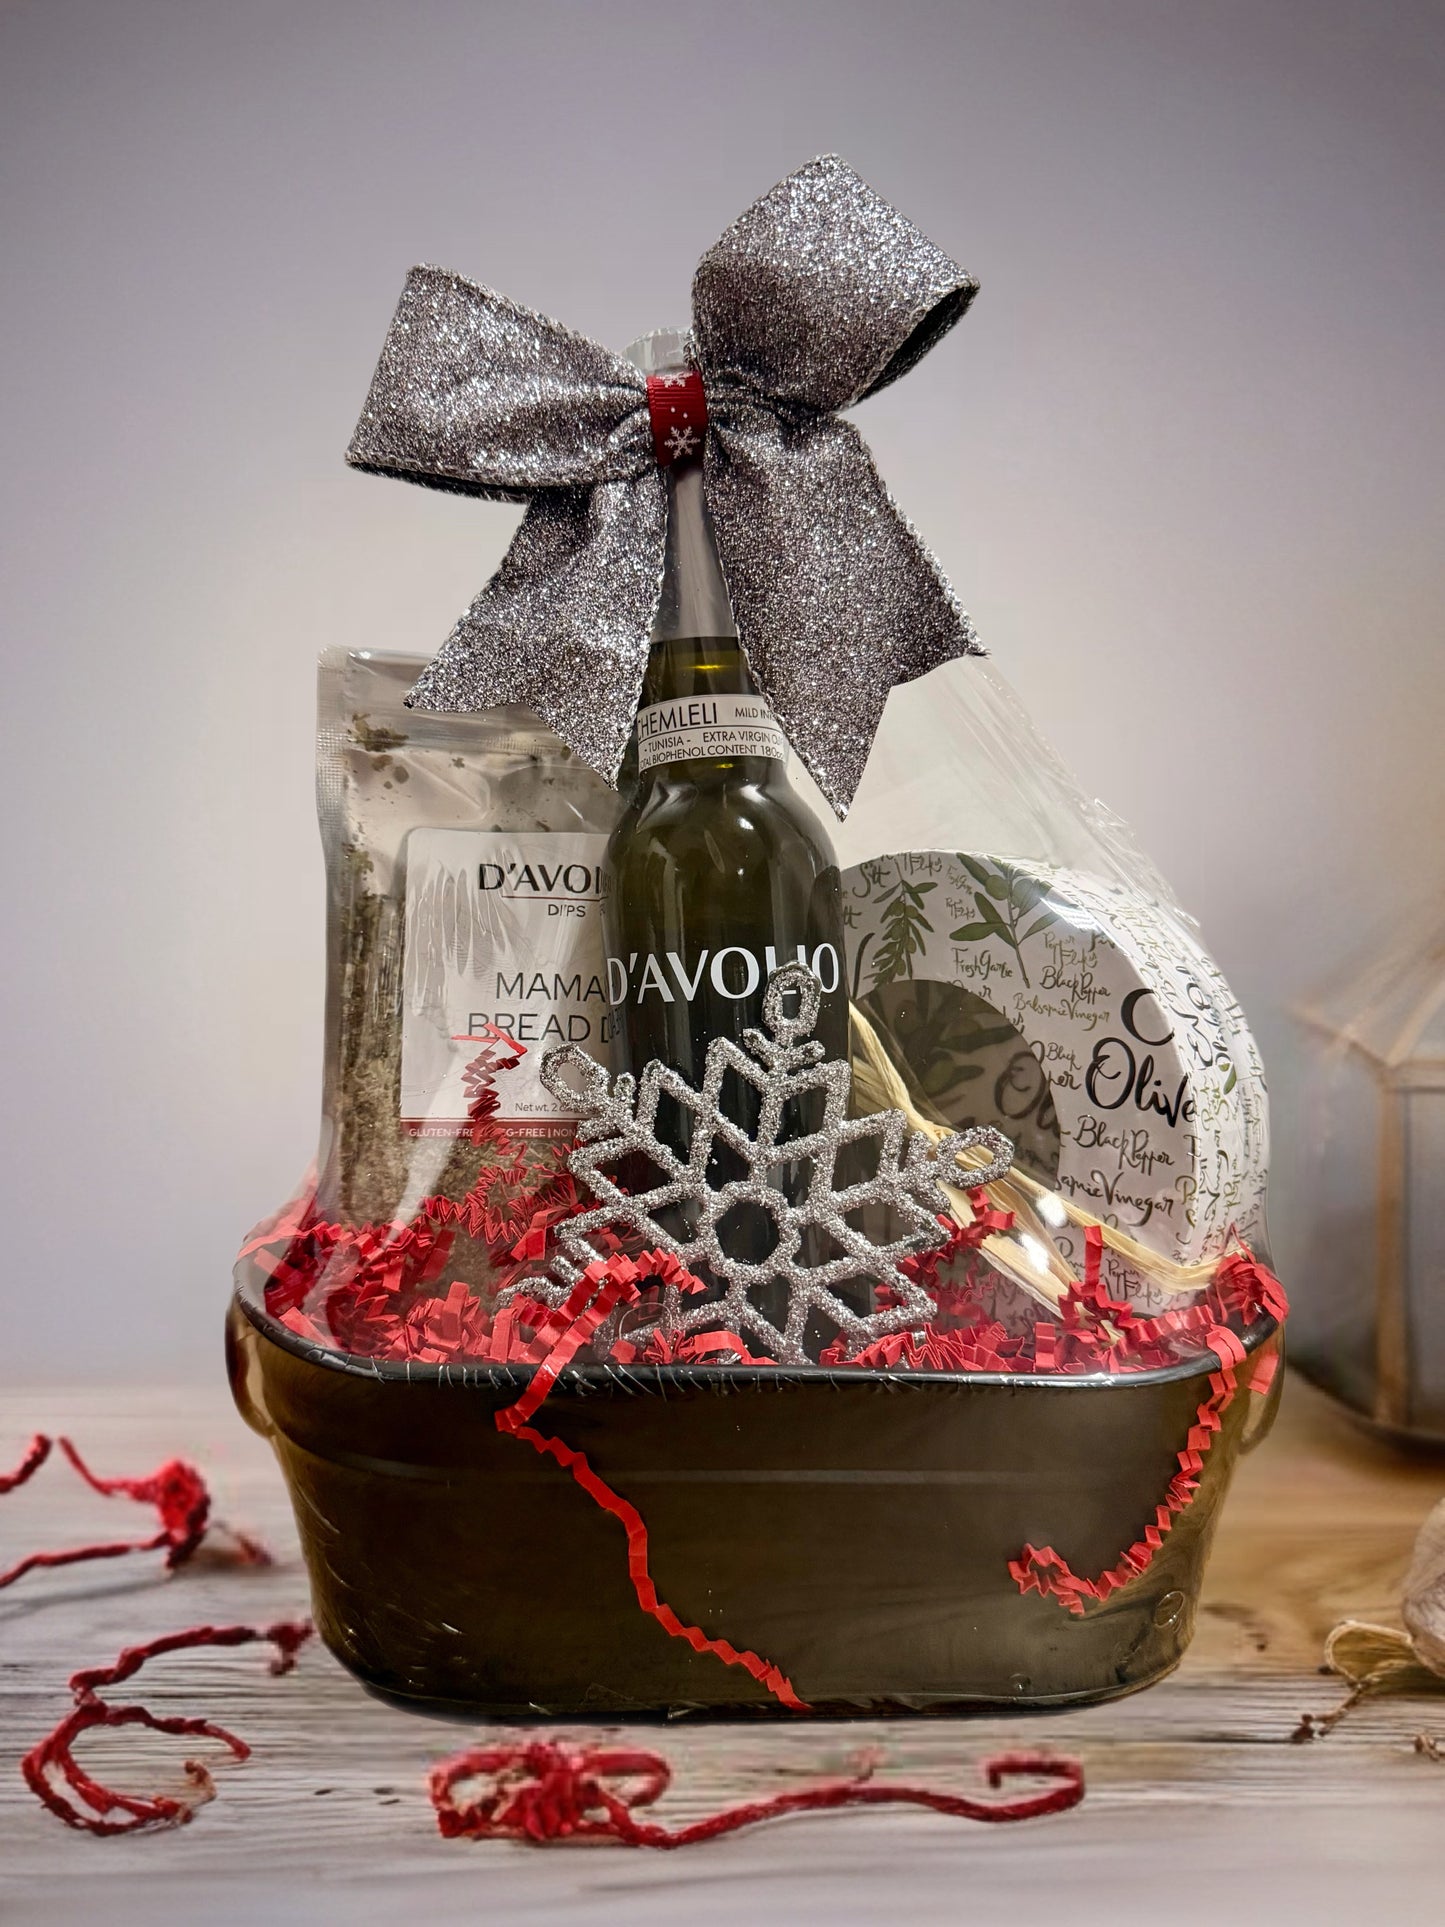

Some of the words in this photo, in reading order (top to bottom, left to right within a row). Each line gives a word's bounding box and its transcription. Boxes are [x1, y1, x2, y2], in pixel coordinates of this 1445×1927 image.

[735, 707, 758, 718] MILD
[649, 736, 684, 752] TUNISIA
[703, 731, 736, 742] EXTRA
[738, 731, 770, 743] VIRGIN
[653, 746, 705, 764] BIOPHENOL
[707, 744, 757, 756] CONTENT
[1040, 966, 1087, 1002] Black
[468, 1013, 590, 1042] BREAD
[1085, 1037, 1196, 1128] Olive
[515, 1103, 533, 1112] Net
[409, 1128, 474, 1138] GLUTEN-FRE
[1073, 1114, 1138, 1170] Black
